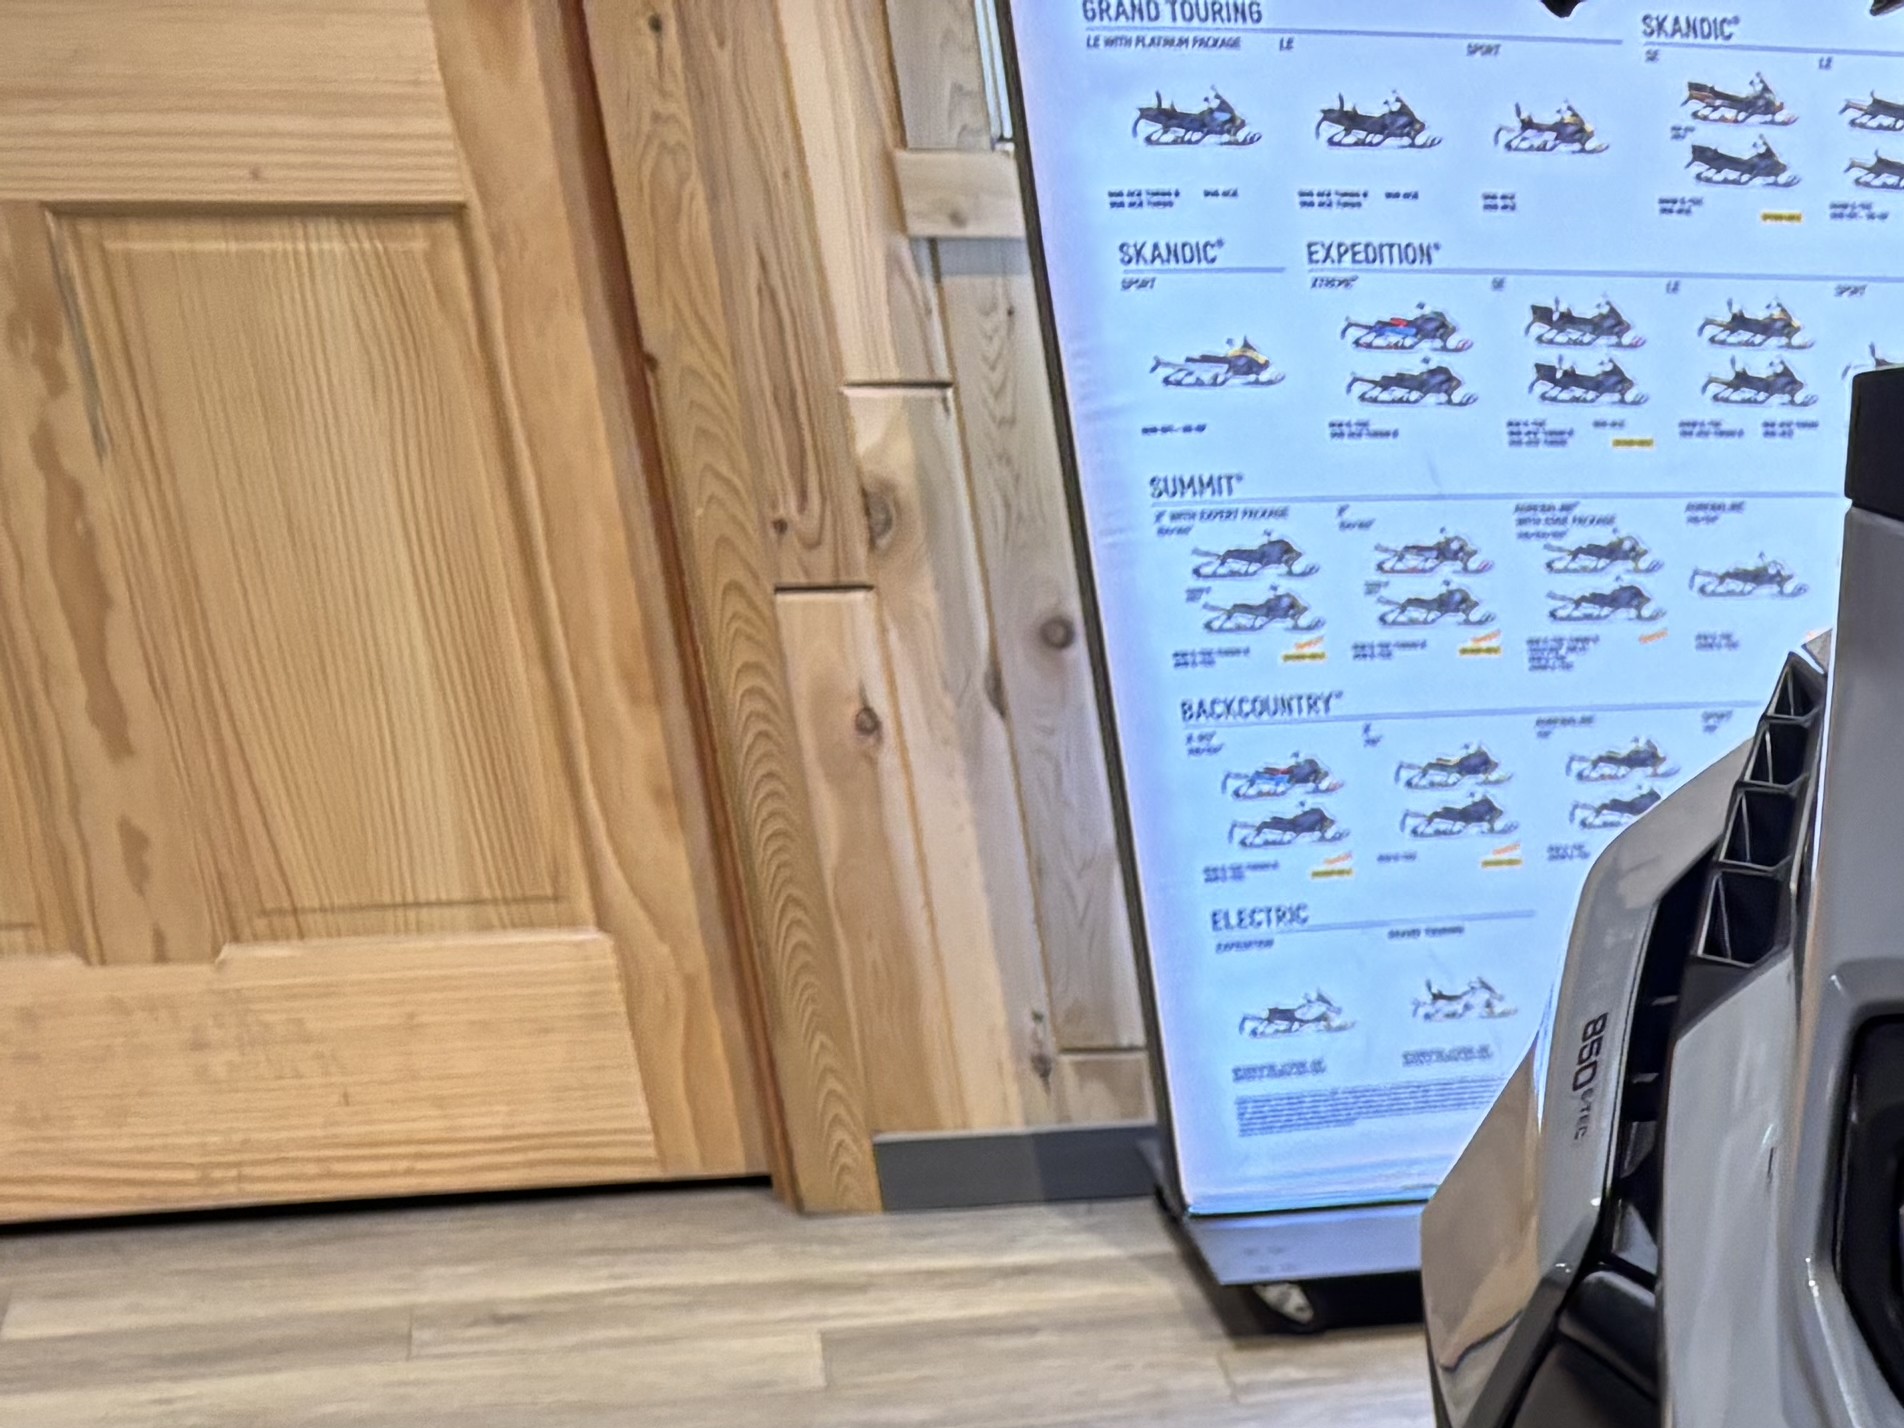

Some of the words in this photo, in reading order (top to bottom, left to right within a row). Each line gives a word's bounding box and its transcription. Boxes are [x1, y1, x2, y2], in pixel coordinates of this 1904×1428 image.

[1082, 0, 1161, 23] GRAND
[1169, 0, 1263, 25] TOURING
[1642, 13, 1736, 41] SKANDIC
[1118, 241, 1219, 267] SKANDIC
[1307, 241, 1434, 266] EXPEDITION
[1149, 473, 1237, 500] SUMMIT
[1181, 693, 1333, 722] BACKCOUNTRY
[1211, 904, 1309, 931] ELECTRIC
[1572, 1012, 1609, 1091] 850
